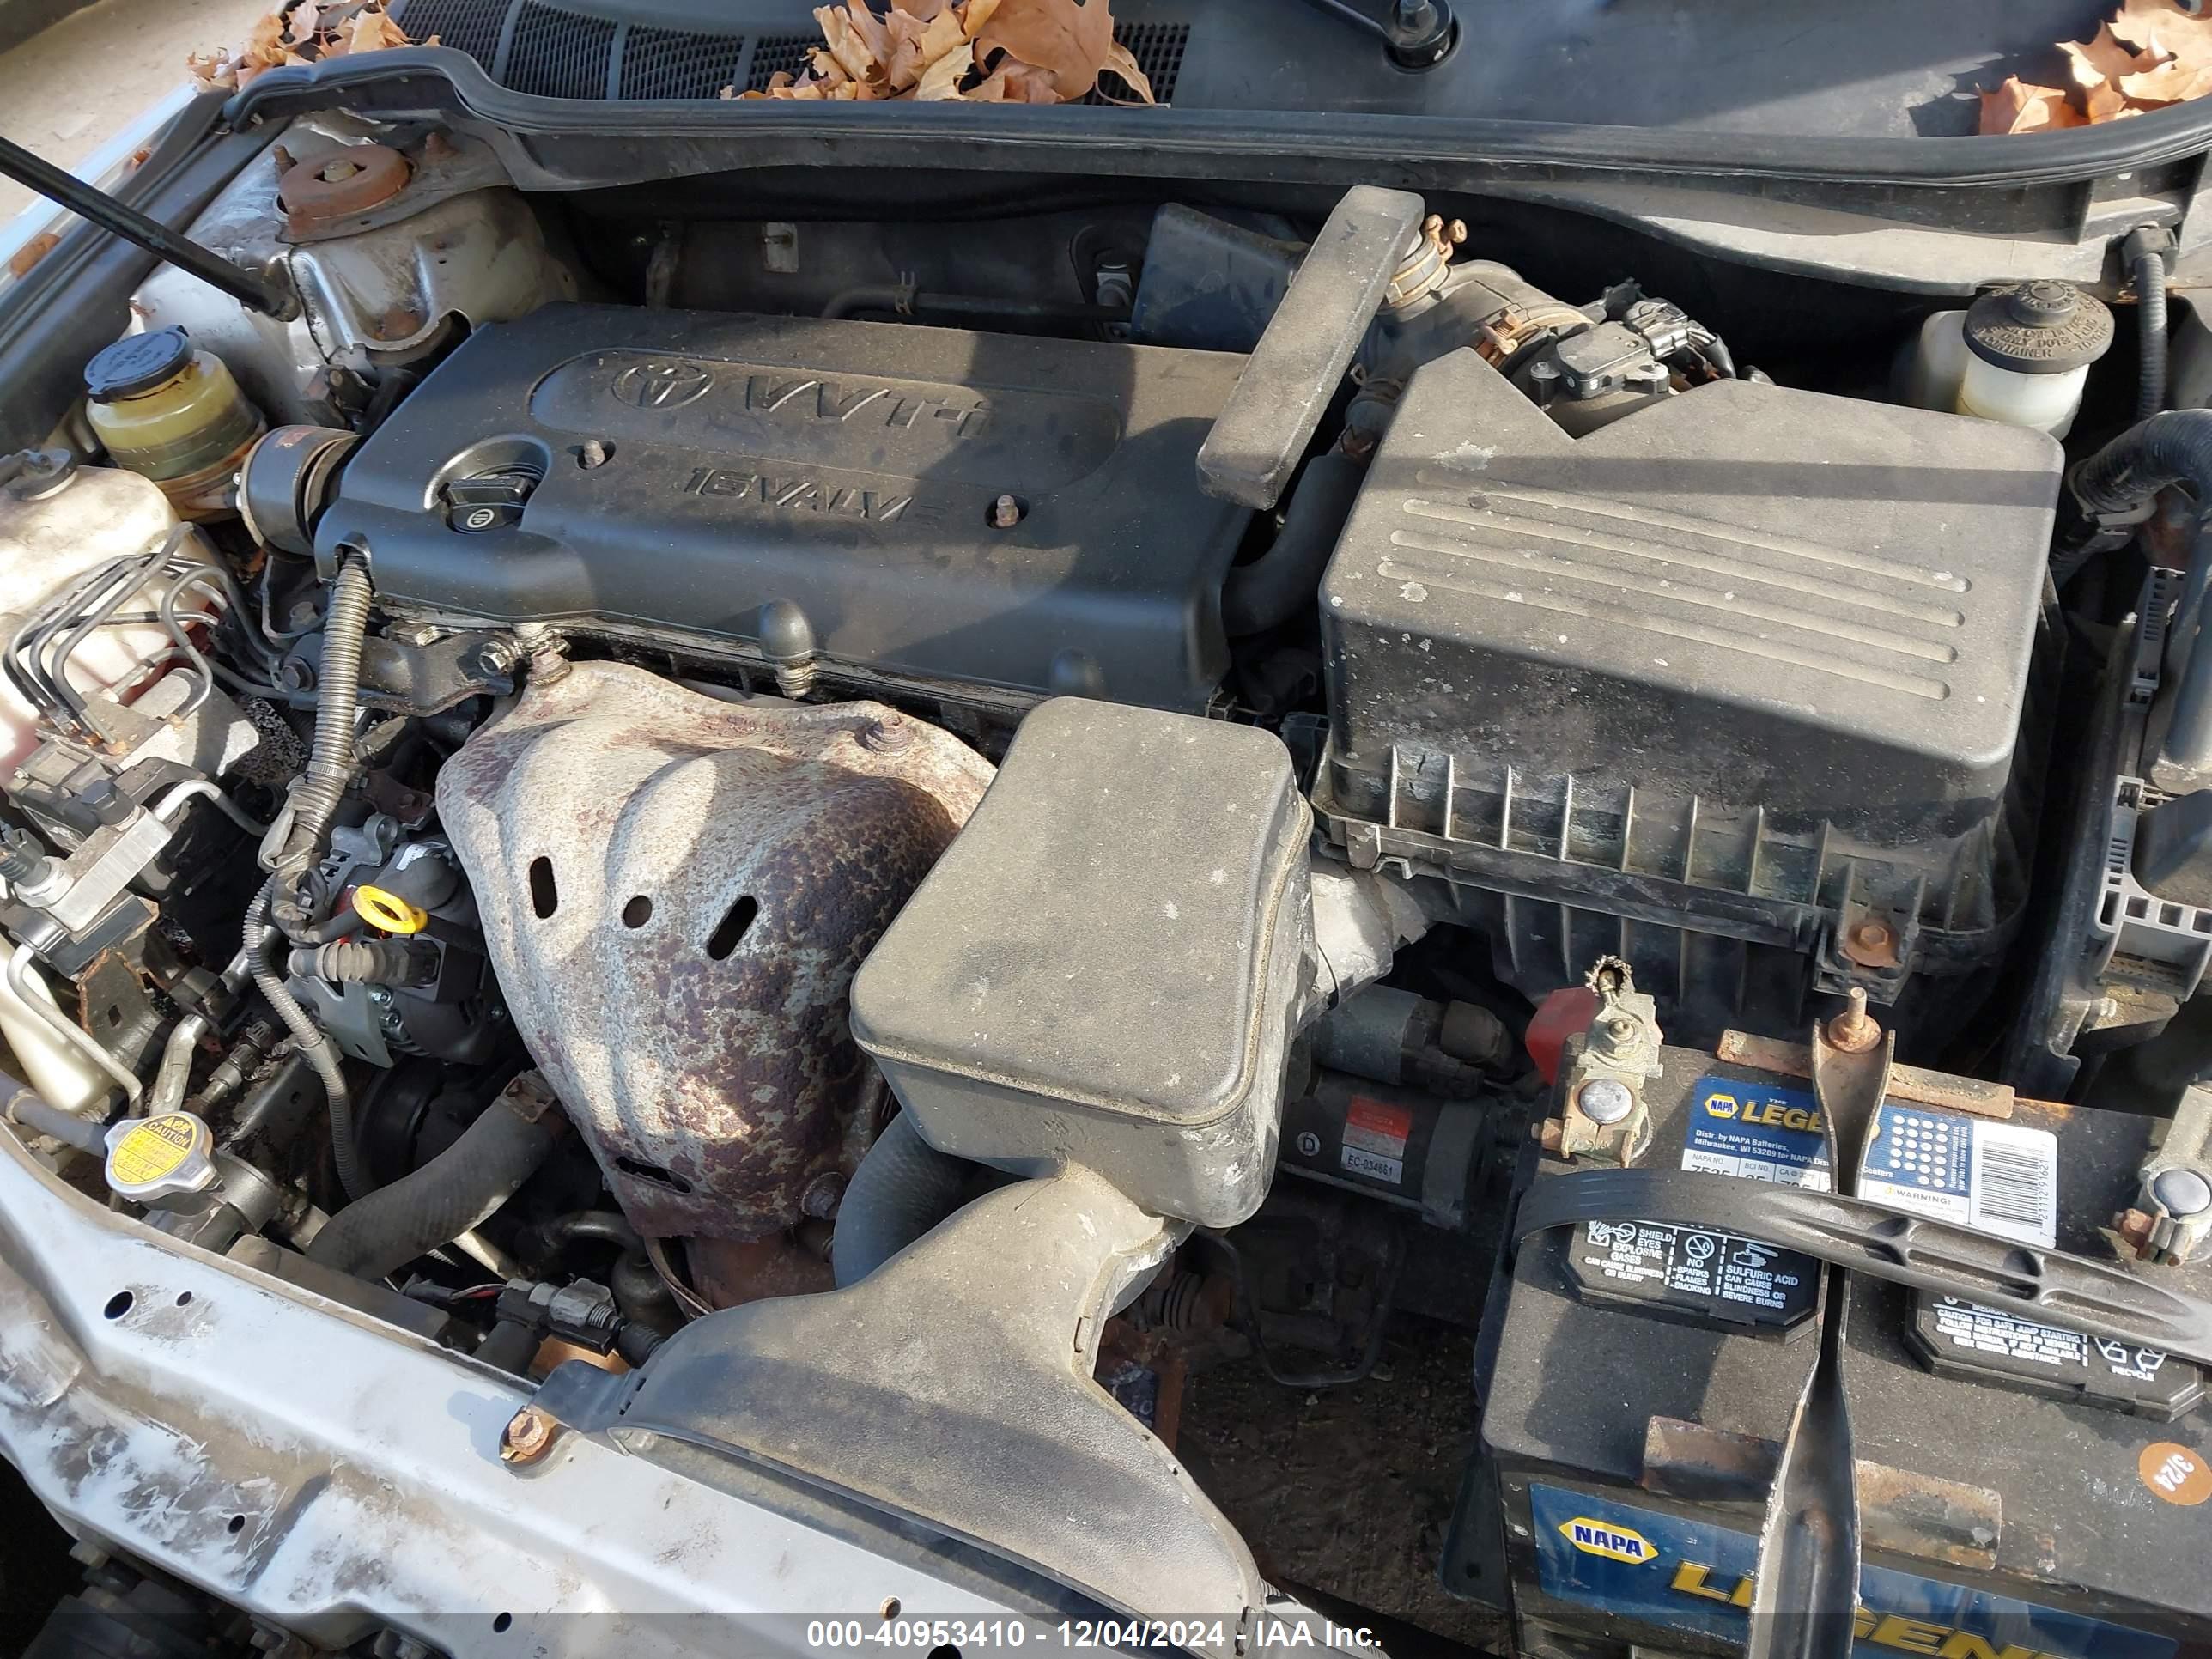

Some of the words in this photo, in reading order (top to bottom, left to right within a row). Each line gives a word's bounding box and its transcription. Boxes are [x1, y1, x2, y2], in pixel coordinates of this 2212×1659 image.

[1711, 1099, 1734, 1113] NAPA
[1741, 1100, 1824, 1133] LEGE
[148, 1121, 191, 1147] CAUTION
[1718, 1133, 1729, 1143] by
[1729, 1134, 1752, 1146] NAPA
[1692, 1153, 1712, 1164] NAPA
[1740, 1145, 1751, 1153] WI
[1752, 1146, 1778, 1158] 53209
[1778, 1150, 1790, 1159] for
[1790, 1152, 1814, 1164] NAPA
[1779, 1168, 1790, 1176] CA
[1638, 1228, 1673, 1243] SHIELD
[1638, 1237, 1662, 1249] EYES
[1610, 1253, 1642, 1265] GASES
[1613, 1242, 1663, 1260] EXPLOSIVE
[1686, 1258, 1705, 1268] NO
[1724, 1274, 1742, 1284] CAN
[1744, 1278, 1773, 1290] CAUSE
[1726, 1265, 1773, 1282] SULFURIC
[1775, 1275, 1799, 1286] ACID
[1723, 1283, 1770, 1297] BLINDNESS
[1773, 1291, 1786, 1301] OR
[1723, 1291, 1754, 1304] SEVERE
[1755, 1297, 1784, 1309] BURNS
[2111, 1365, 2155, 1382] RECYCLE
[1574, 1525, 1643, 1558] NAPA
